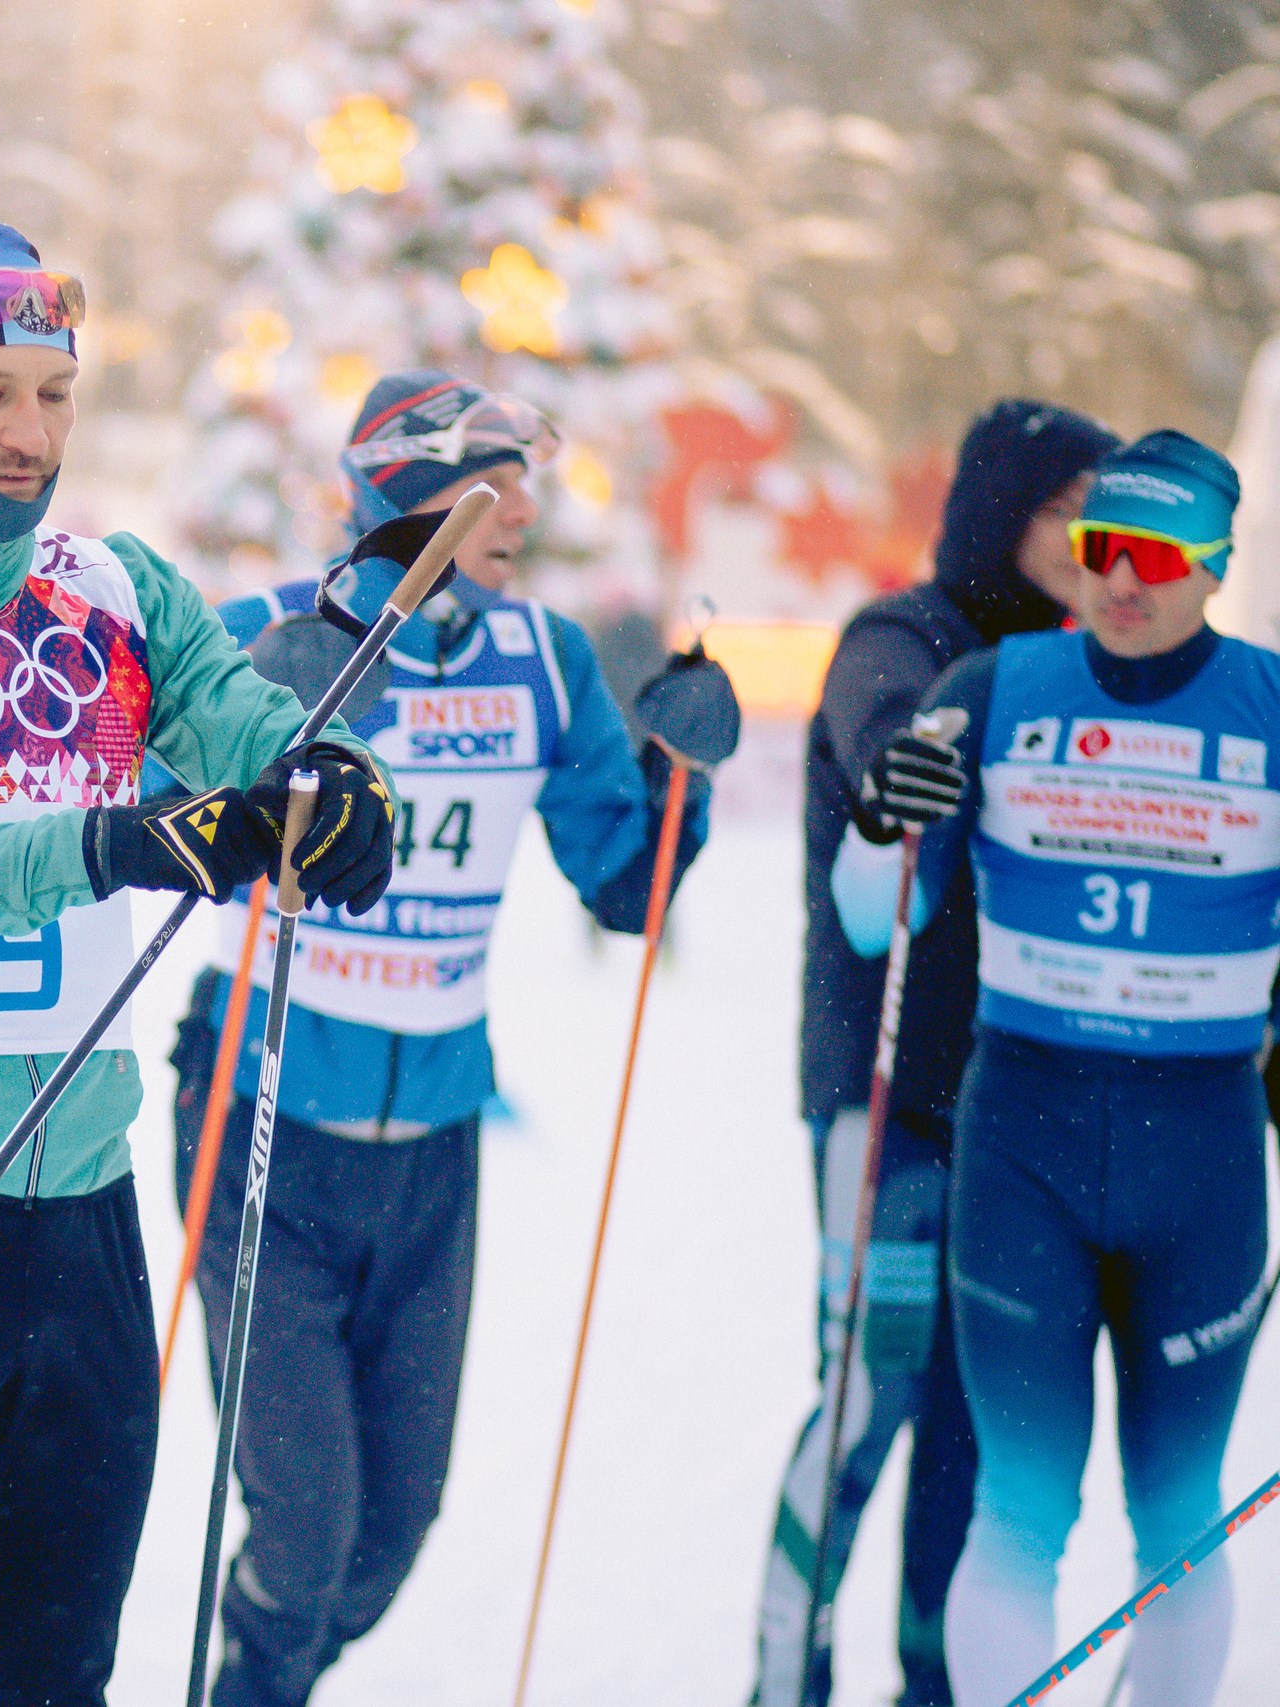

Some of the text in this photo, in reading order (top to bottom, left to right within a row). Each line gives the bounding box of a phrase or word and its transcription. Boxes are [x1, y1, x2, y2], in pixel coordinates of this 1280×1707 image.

[410, 696, 516, 727] INTER
[410, 731, 516, 758] SPORT
[256, 805, 285, 843] FISC
[302, 801, 353, 870] FISCHER
[1077, 872, 1152, 939] 31
[247, 1044, 278, 1218] SWIX
